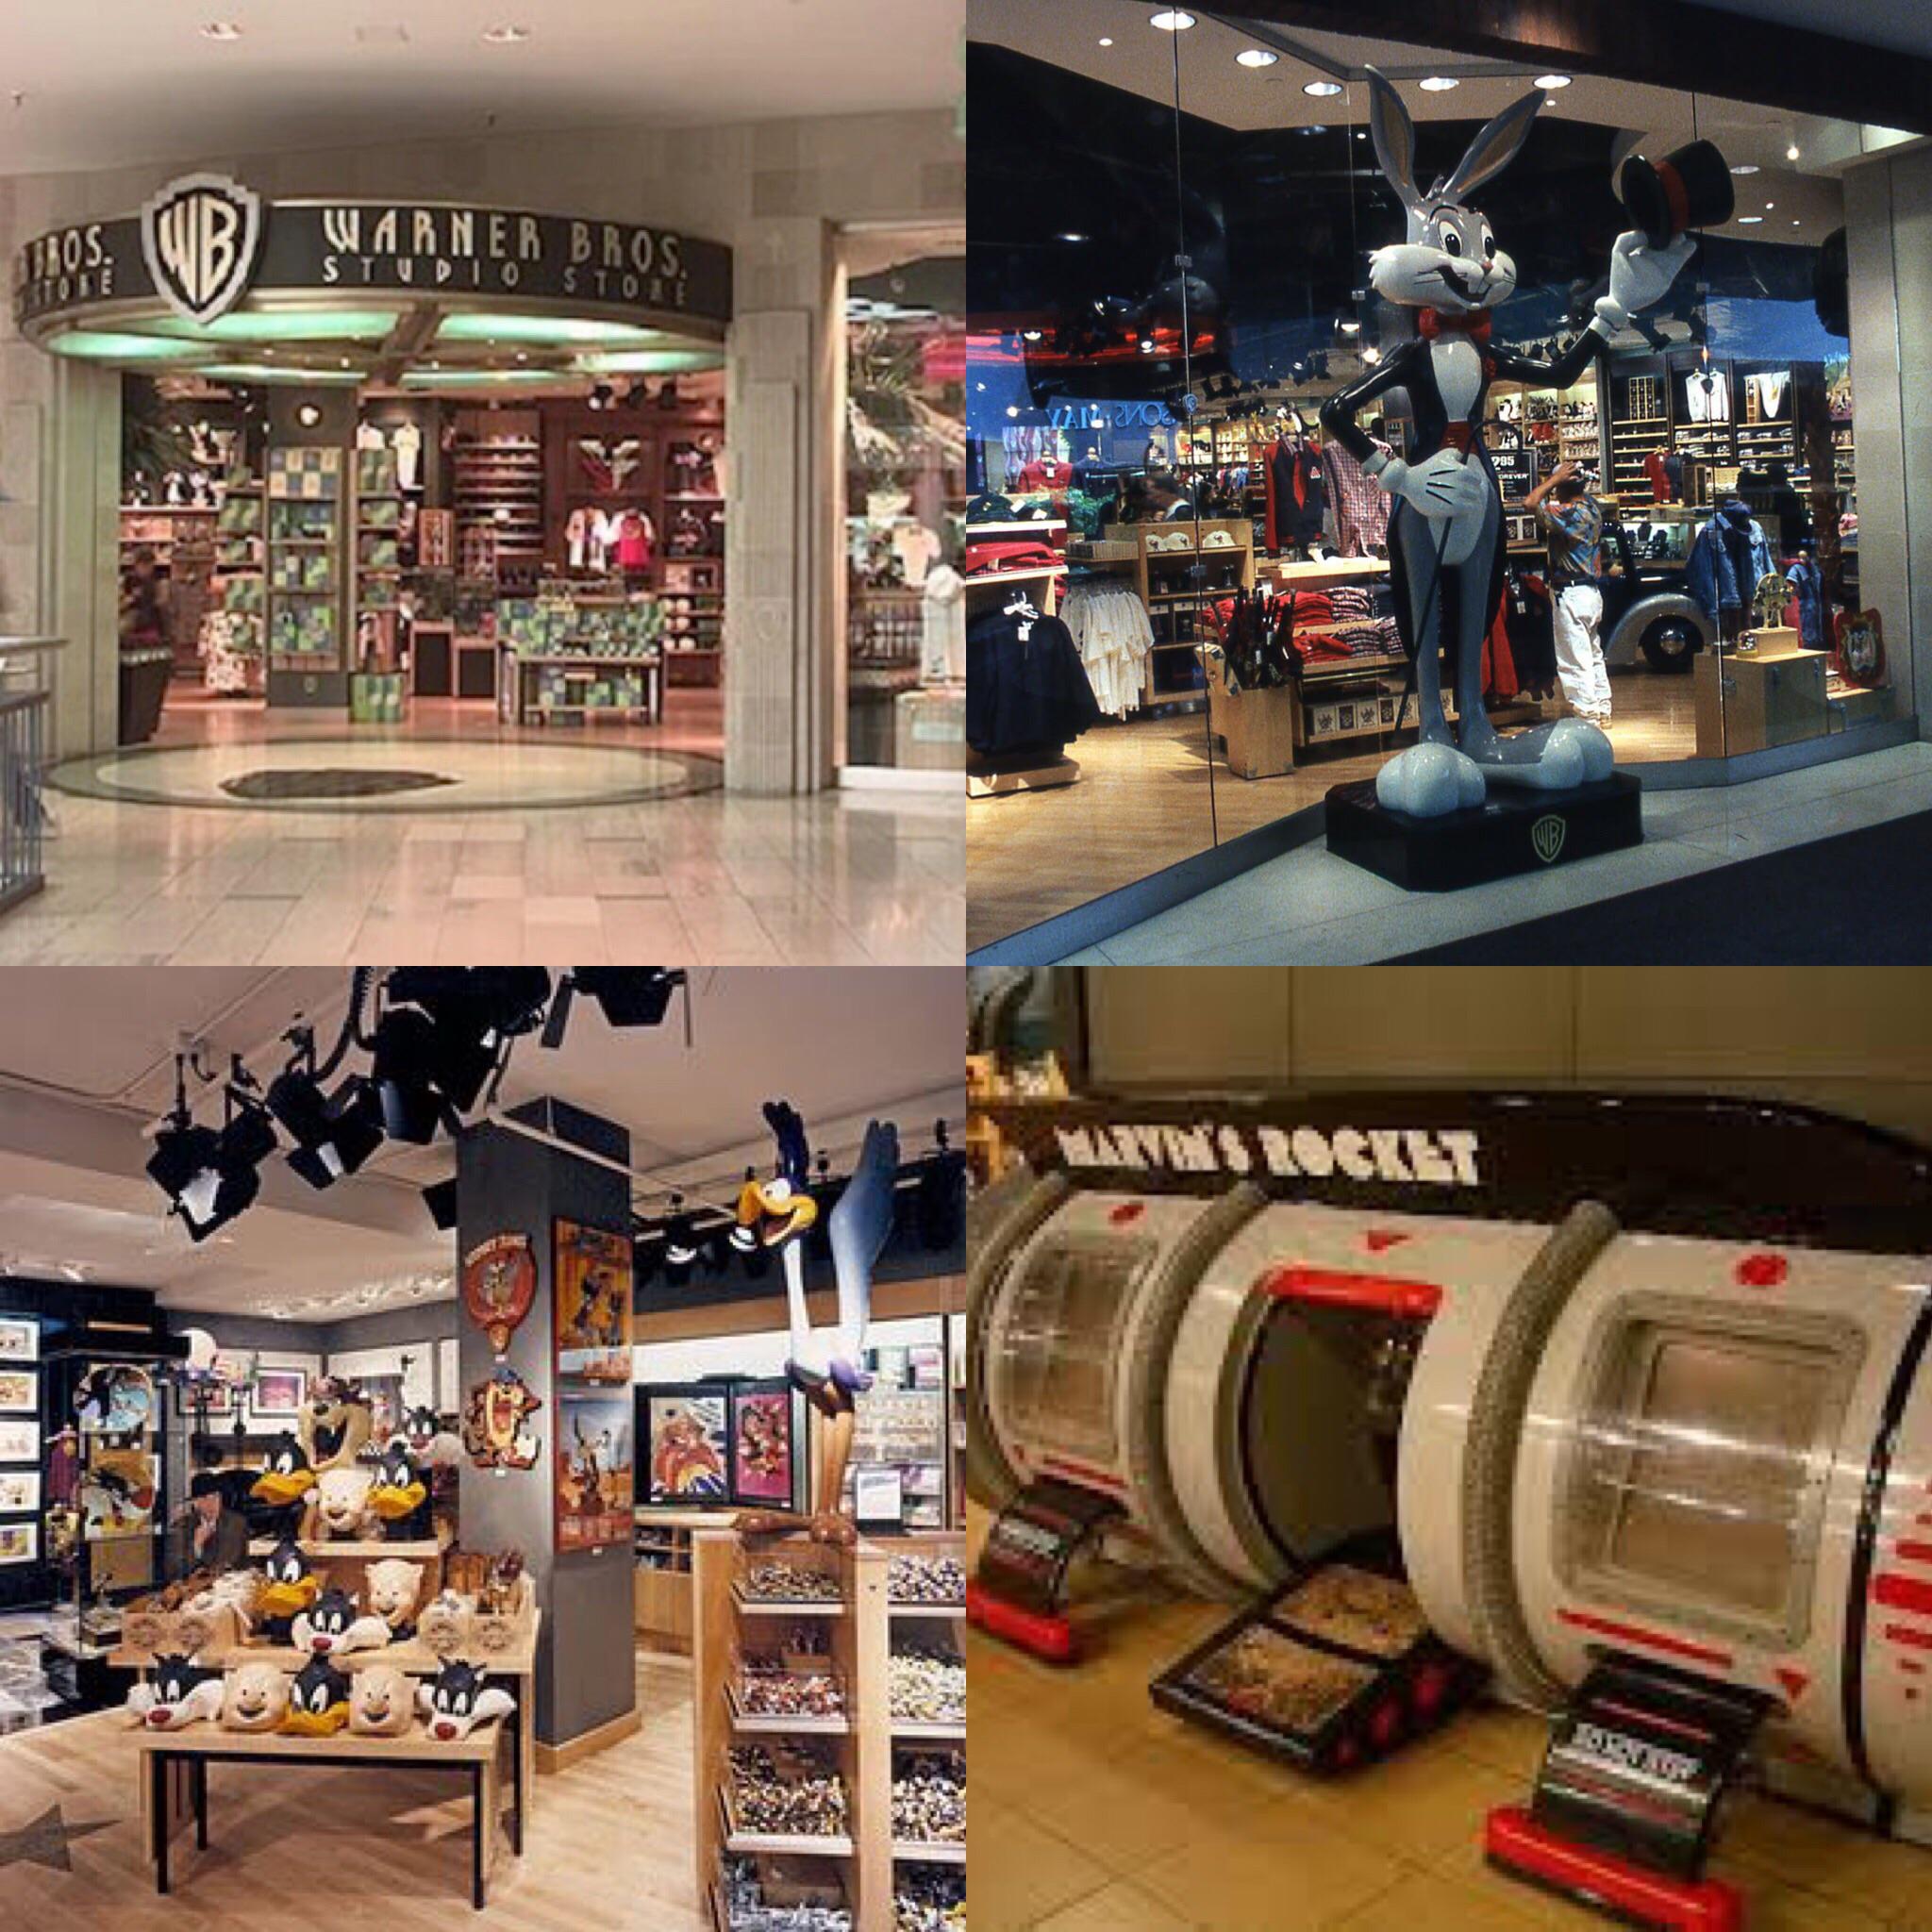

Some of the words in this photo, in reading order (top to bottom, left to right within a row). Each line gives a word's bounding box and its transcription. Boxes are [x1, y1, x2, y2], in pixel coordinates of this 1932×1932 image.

[158, 192, 237, 304] WB
[324, 208, 541, 261] WARNER
[571, 221, 688, 280] BROS.
[323, 255, 519, 287] STUDIO
[564, 266, 686, 306] STORE
[1257, 1125, 1478, 1186] ROCKET
